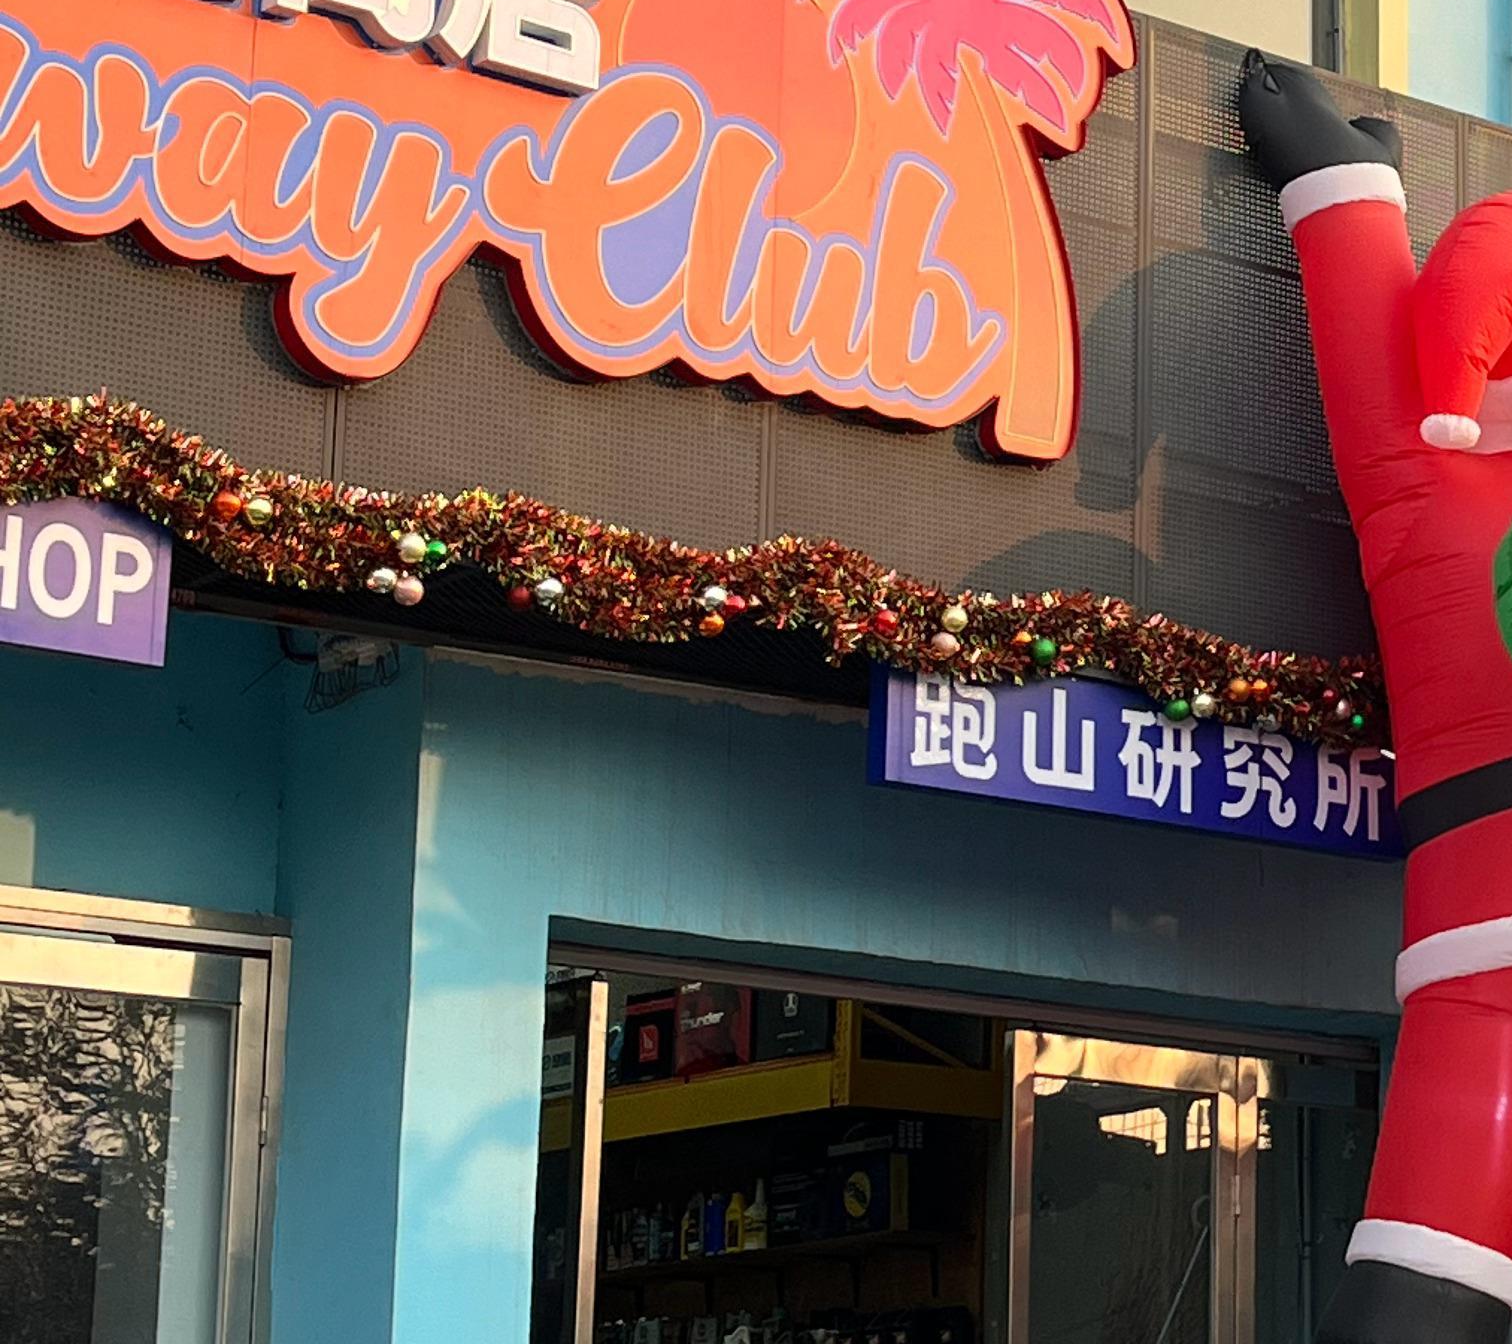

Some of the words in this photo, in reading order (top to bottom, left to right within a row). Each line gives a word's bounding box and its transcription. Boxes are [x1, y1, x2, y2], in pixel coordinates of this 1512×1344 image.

[483, 71, 1002, 401] Club
[909, 672, 1390, 842] 跑山研究所
